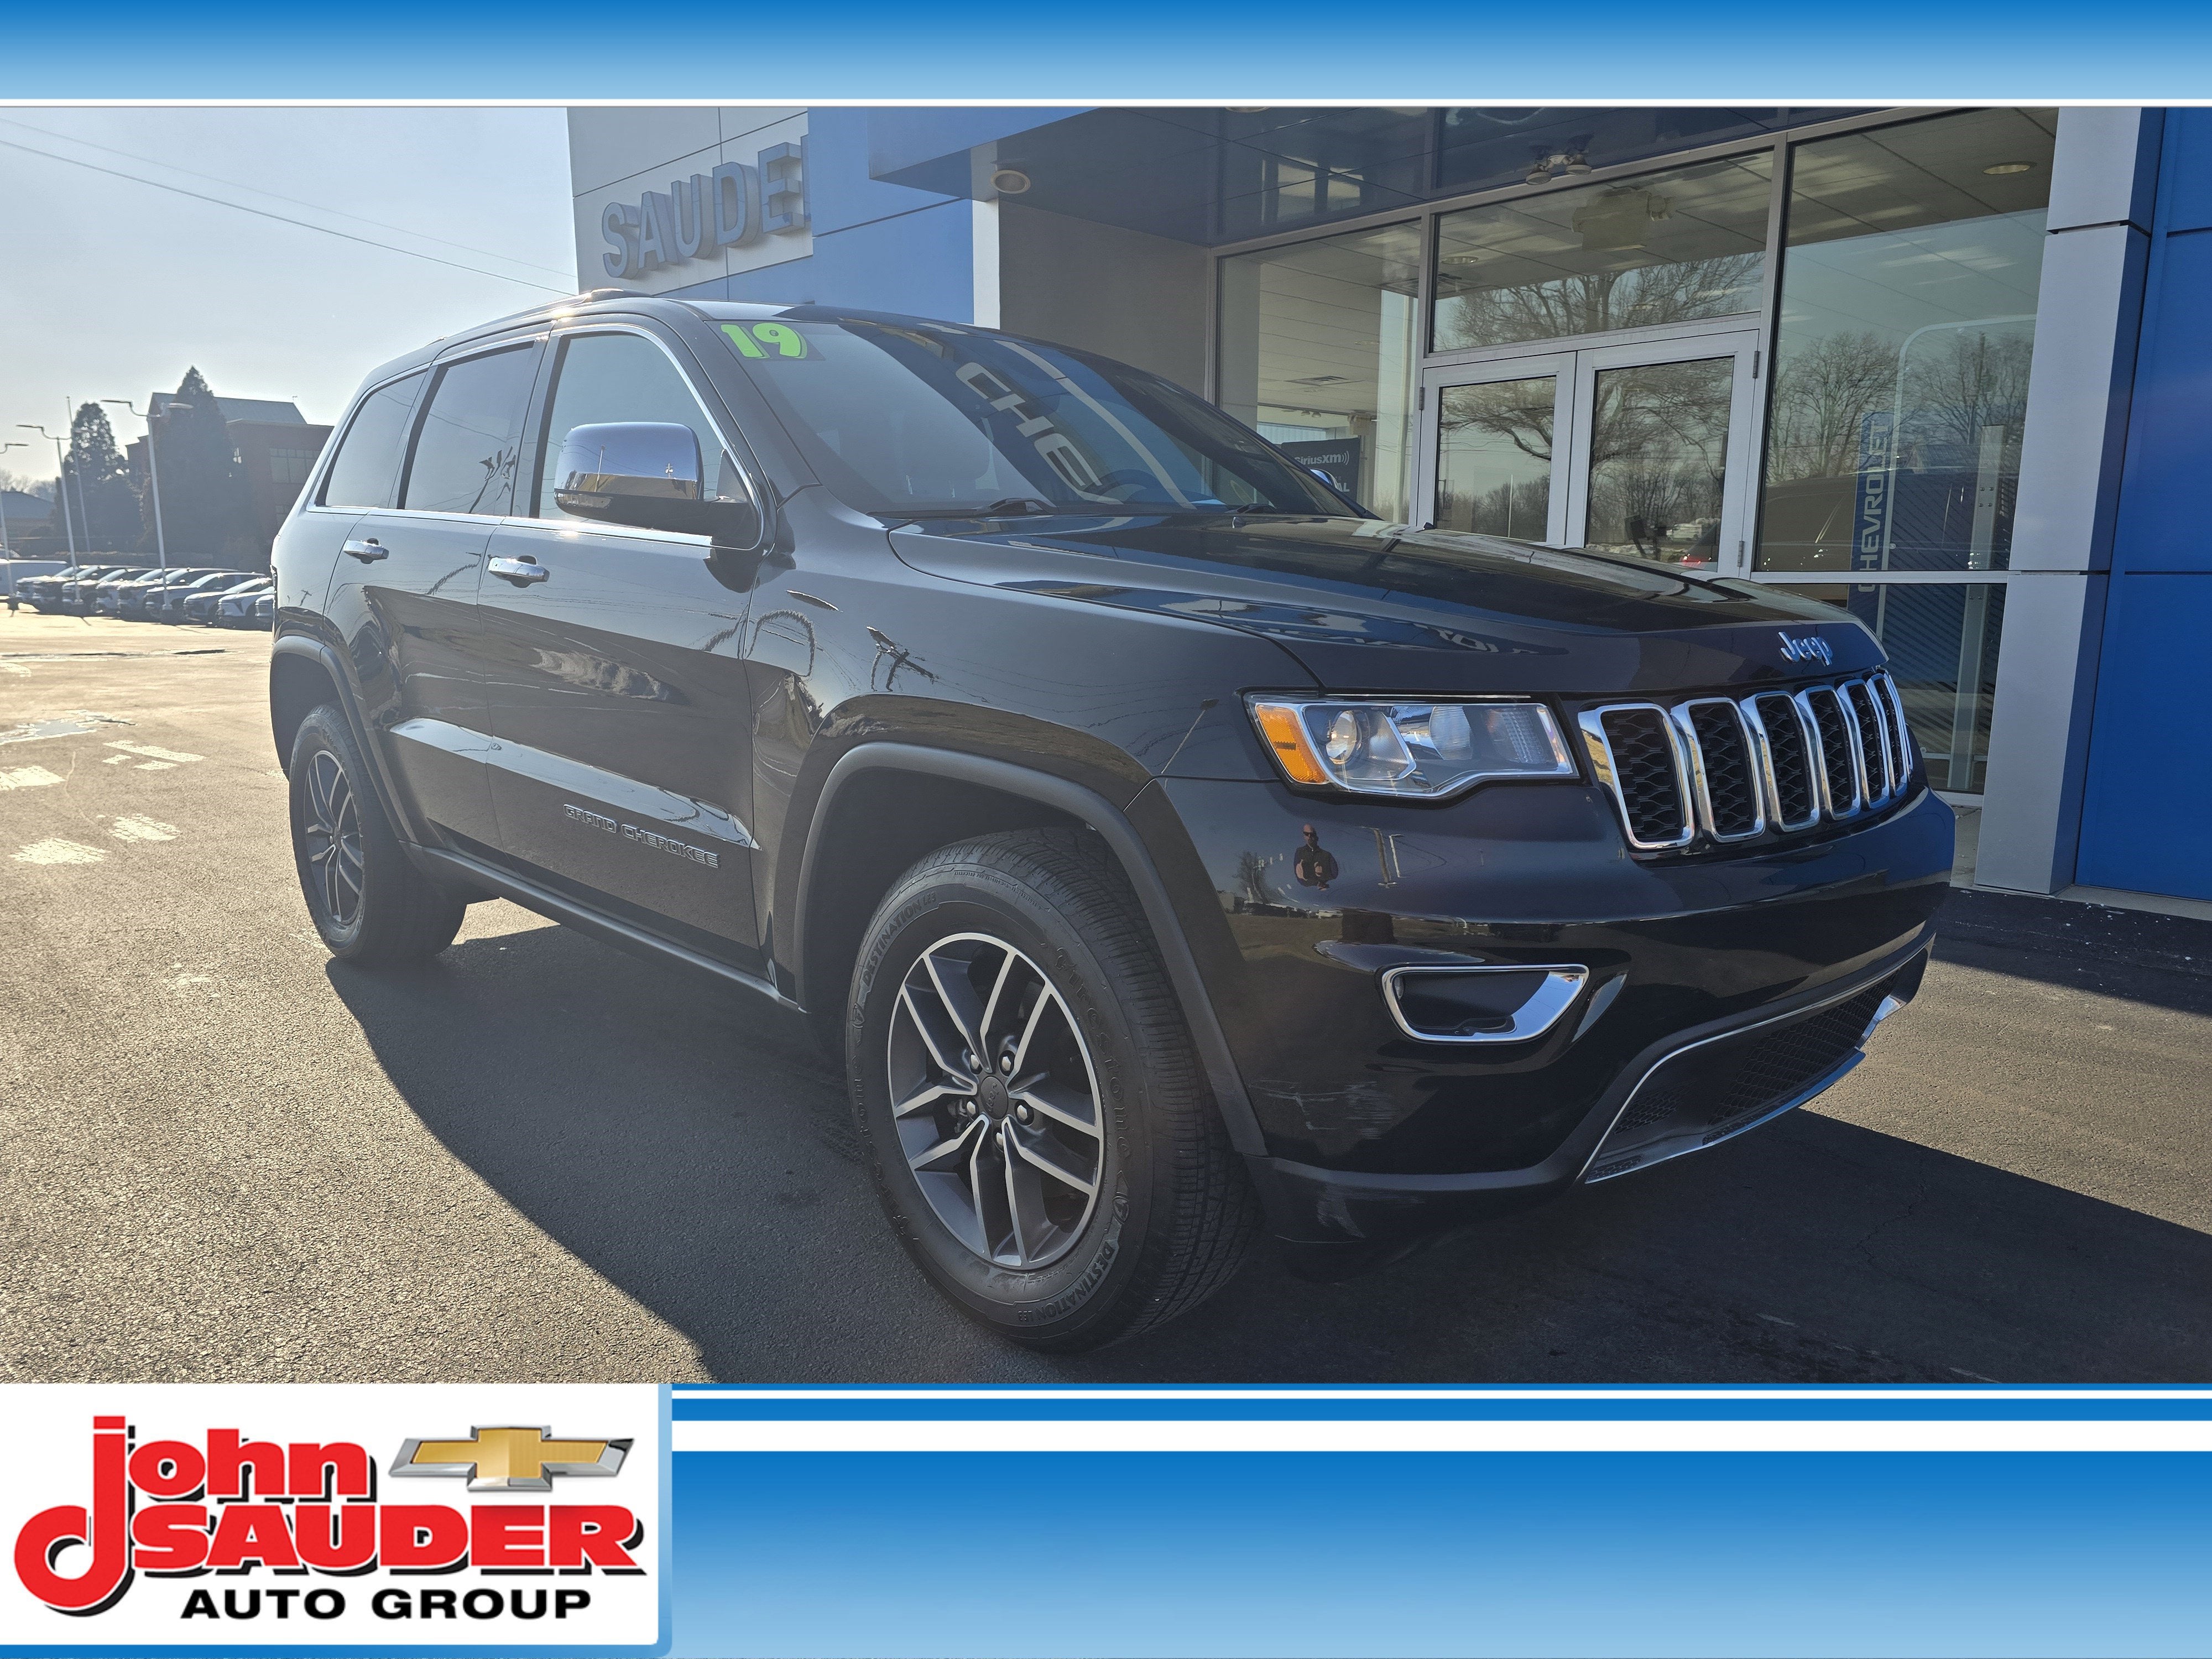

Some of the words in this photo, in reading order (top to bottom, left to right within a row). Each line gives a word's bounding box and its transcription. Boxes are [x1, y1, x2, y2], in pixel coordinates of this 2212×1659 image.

[602, 136, 810, 279] SAUDE
[721, 322, 808, 359] 19
[1778, 632, 1833, 666] Jeep
[563, 804, 618, 834] GRAND
[621, 823, 720, 869] CHEROKEE
[860, 897, 924, 987] DESTINATION
[1035, 1240, 1115, 1320] DESTINATION
